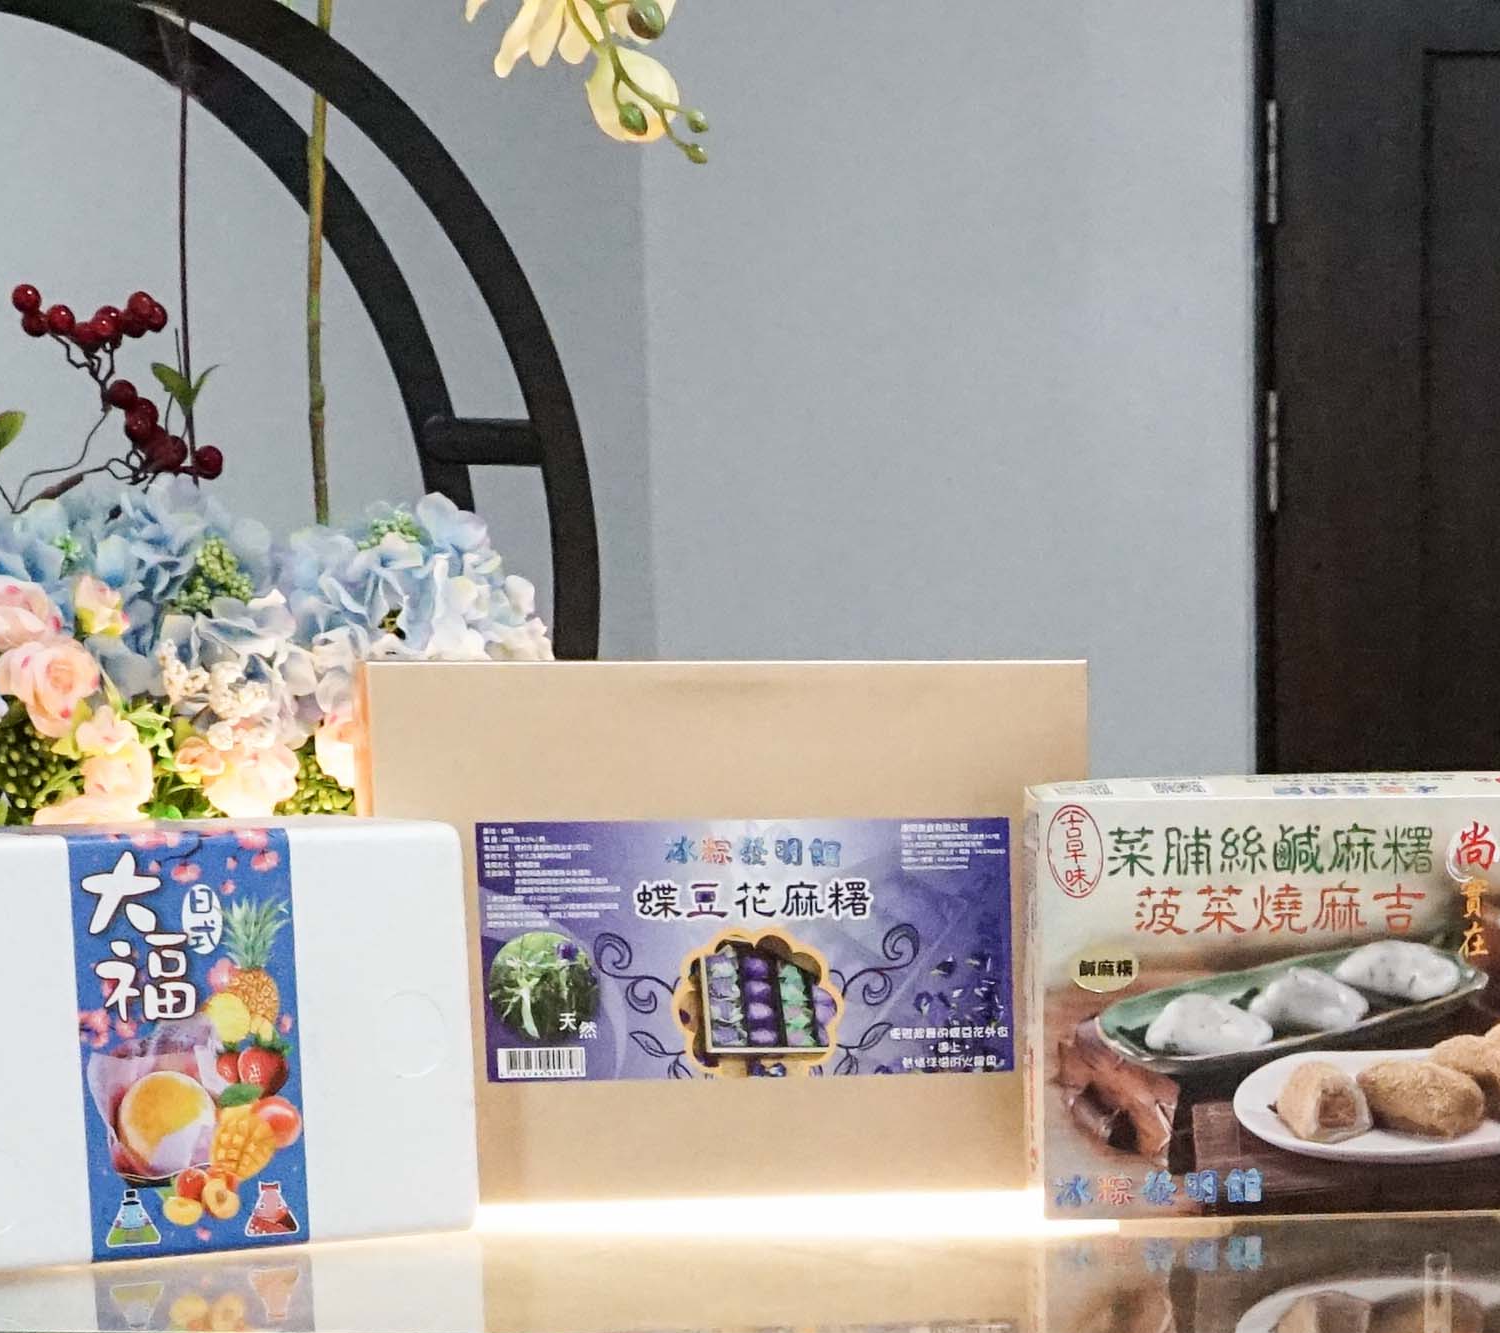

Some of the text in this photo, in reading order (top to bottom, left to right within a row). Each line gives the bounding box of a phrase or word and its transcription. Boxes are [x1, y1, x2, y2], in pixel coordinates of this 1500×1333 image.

[1056, 808, 1094, 894] 古早味
[1107, 822, 1434, 879] 菜脯絲鹹麻糬
[635, 880, 872, 921] 蝶豆花麻糬
[1134, 881, 1427, 936] 菠菜燒麻吉
[80, 850, 197, 1022] 大福
[559, 1010, 597, 1039] 天然
